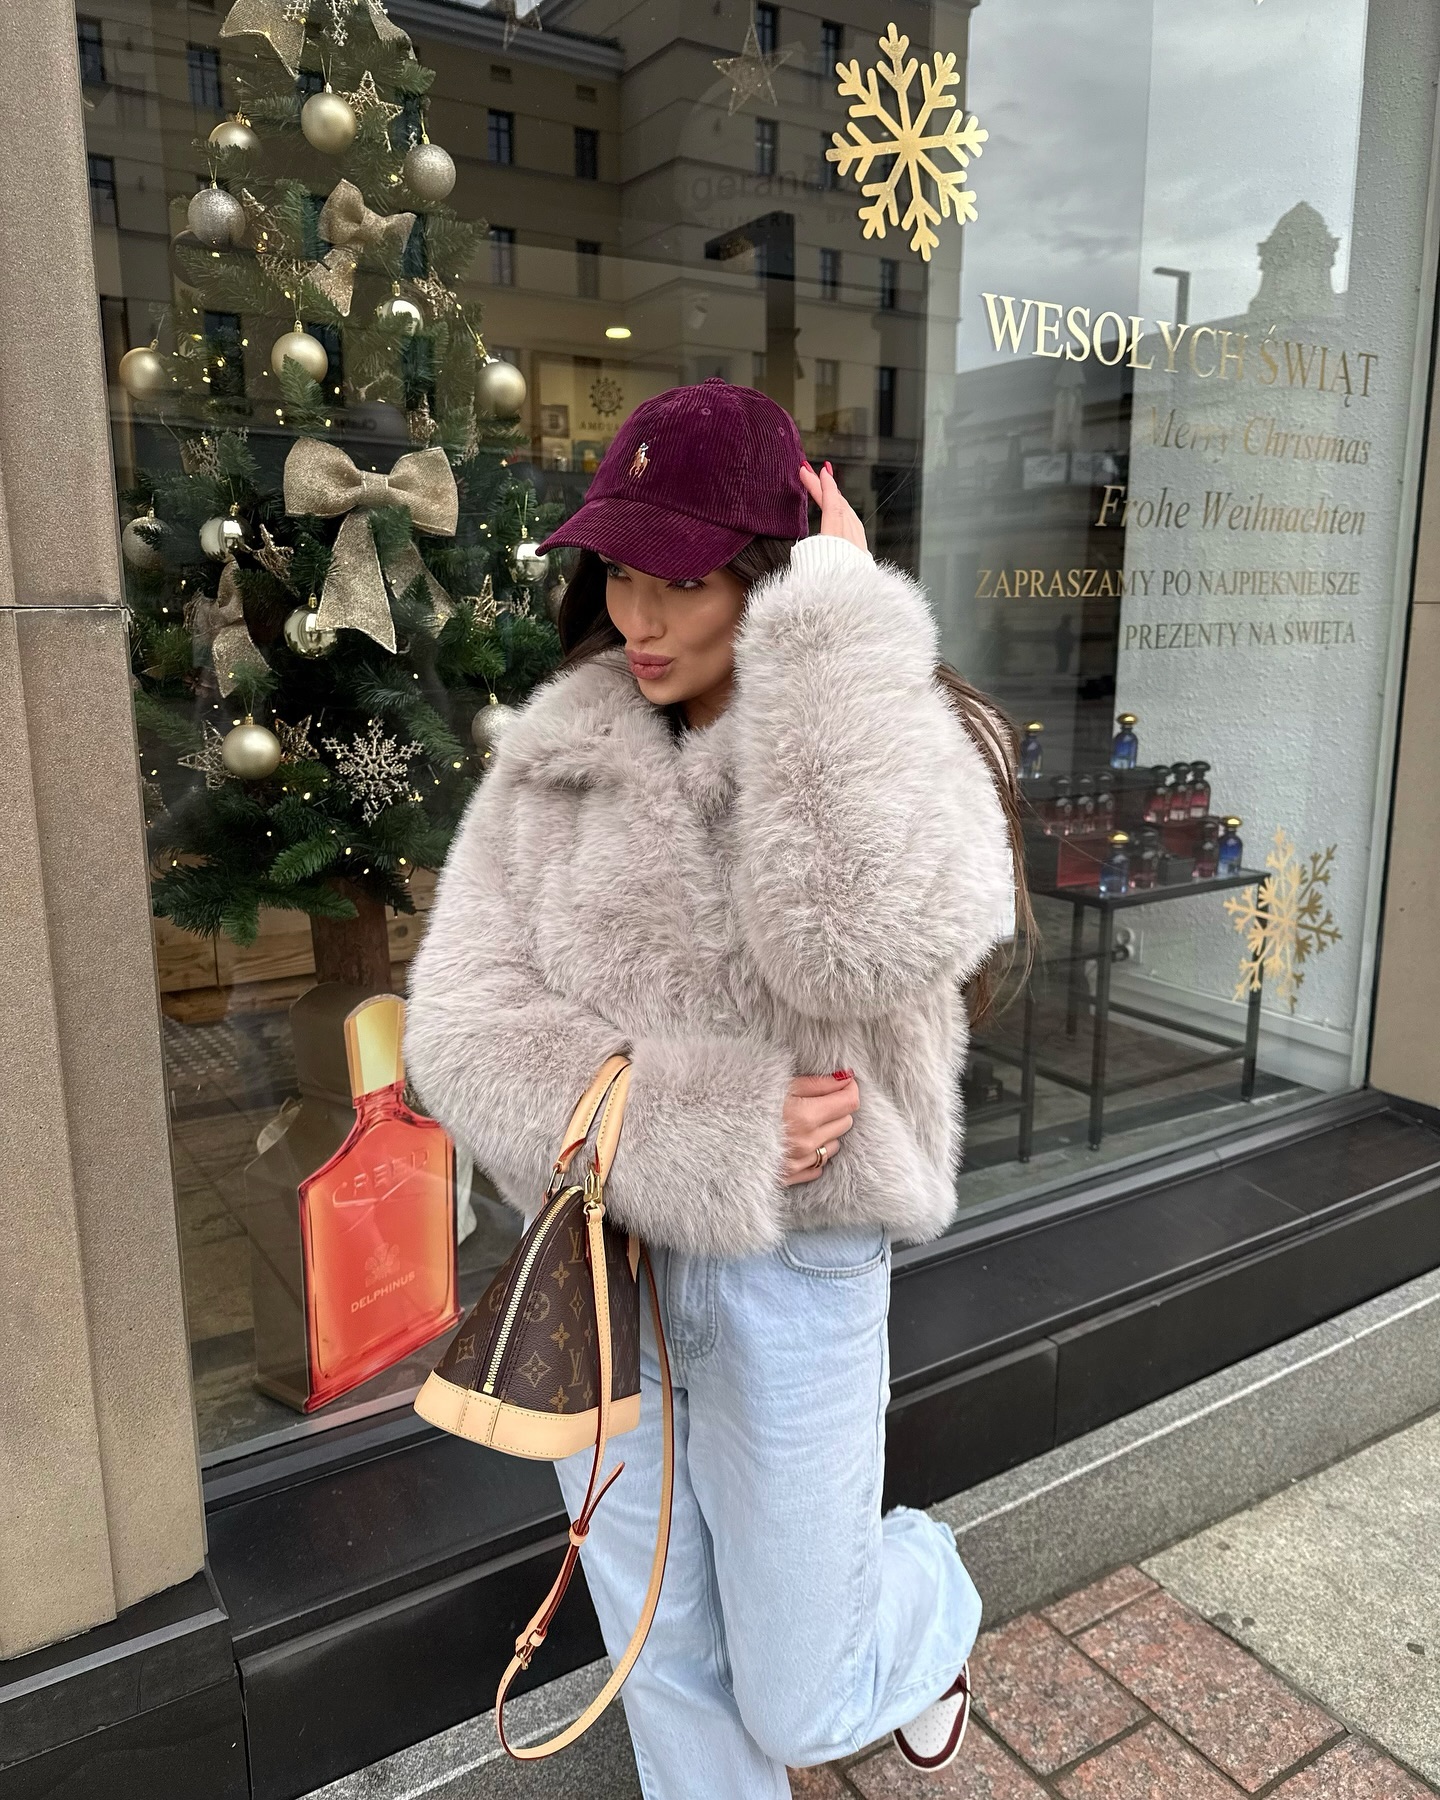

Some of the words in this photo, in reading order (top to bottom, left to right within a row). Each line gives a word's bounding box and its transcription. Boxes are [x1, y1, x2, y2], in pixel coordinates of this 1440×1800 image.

[982, 292, 1249, 380] WESOŁYCH
[1257, 324, 1379, 408] ŚWIĄT
[1243, 416, 1373, 465] Christmas
[1095, 485, 1191, 529] Frohe
[1200, 490, 1366, 536] Weihnachten
[974, 569, 1155, 599] ZAPRASZAMY
[1162, 570, 1192, 597] PO
[1124, 622, 1243, 650] PREZENTY
[1249, 620, 1277, 646] NA
[351, 1270, 416, 1314] DELPHINUS
